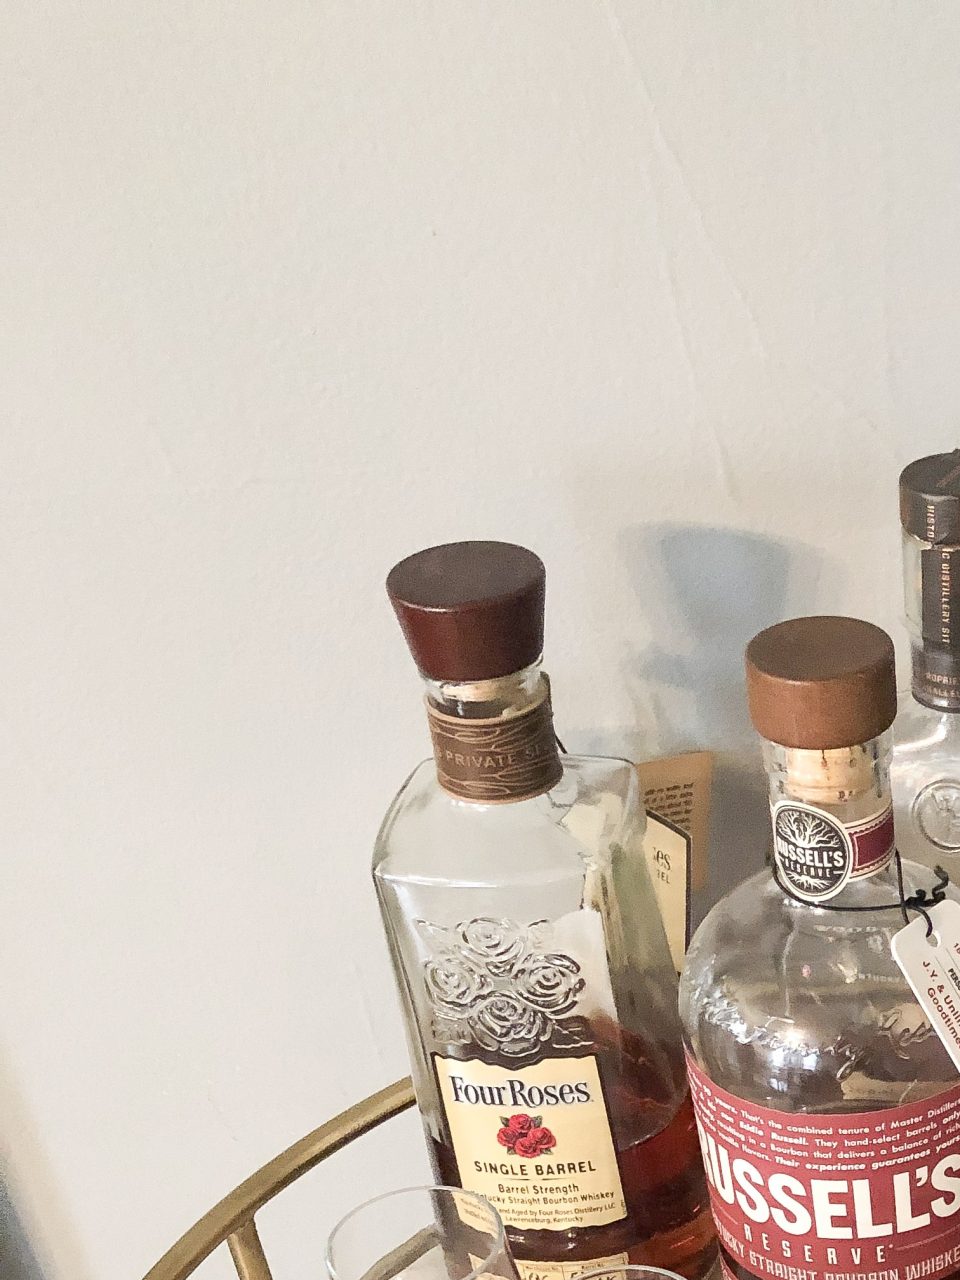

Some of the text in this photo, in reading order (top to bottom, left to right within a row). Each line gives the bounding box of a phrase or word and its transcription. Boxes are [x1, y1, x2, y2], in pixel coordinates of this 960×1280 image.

[445, 750, 515, 768] PRIVATE
[776, 835, 844, 867] RUSSELL'S
[785, 858, 831, 878] RESERVE
[936, 984, 945, 994] &
[449, 1075, 591, 1108] Four Roses
[740, 1109, 764, 1125] That's
[768, 1119, 783, 1130] the
[786, 1125, 833, 1135] combined
[838, 1126, 870, 1135] tenure
[874, 1122, 886, 1132] of
[890, 1115, 923, 1130] Master
[739, 1121, 765, 1136] Eddie
[770, 1131, 809, 1146] Russell.
[814, 1138, 838, 1149] They
[844, 1133, 901, 1147] hand-select
[906, 1121, 938, 1138] barrels
[770, 1143, 809, 1158] Bourbon
[813, 1150, 832, 1159] that
[837, 1150, 875, 1160] delivers
[892, 1138, 929, 1154] balance
[932, 1131, 942, 1141] of
[474, 1160, 597, 1176] SINGLE BARREL
[774, 1156, 800, 1168] Their
[805, 1162, 866, 1173] experience
[872, 1148, 931, 1170] guarantees
[498, 1183, 579, 1195] Barrel Strength
[508, 1196, 540, 1205] Straight
[543, 1196, 579, 1205] Bourbon
[580, 1191, 615, 1202] Whiskey
[553, 1215, 583, 1224] Kentucky
[574, 1204, 603, 1215] Distillery
[744, 1223, 887, 1266] RESERVE
